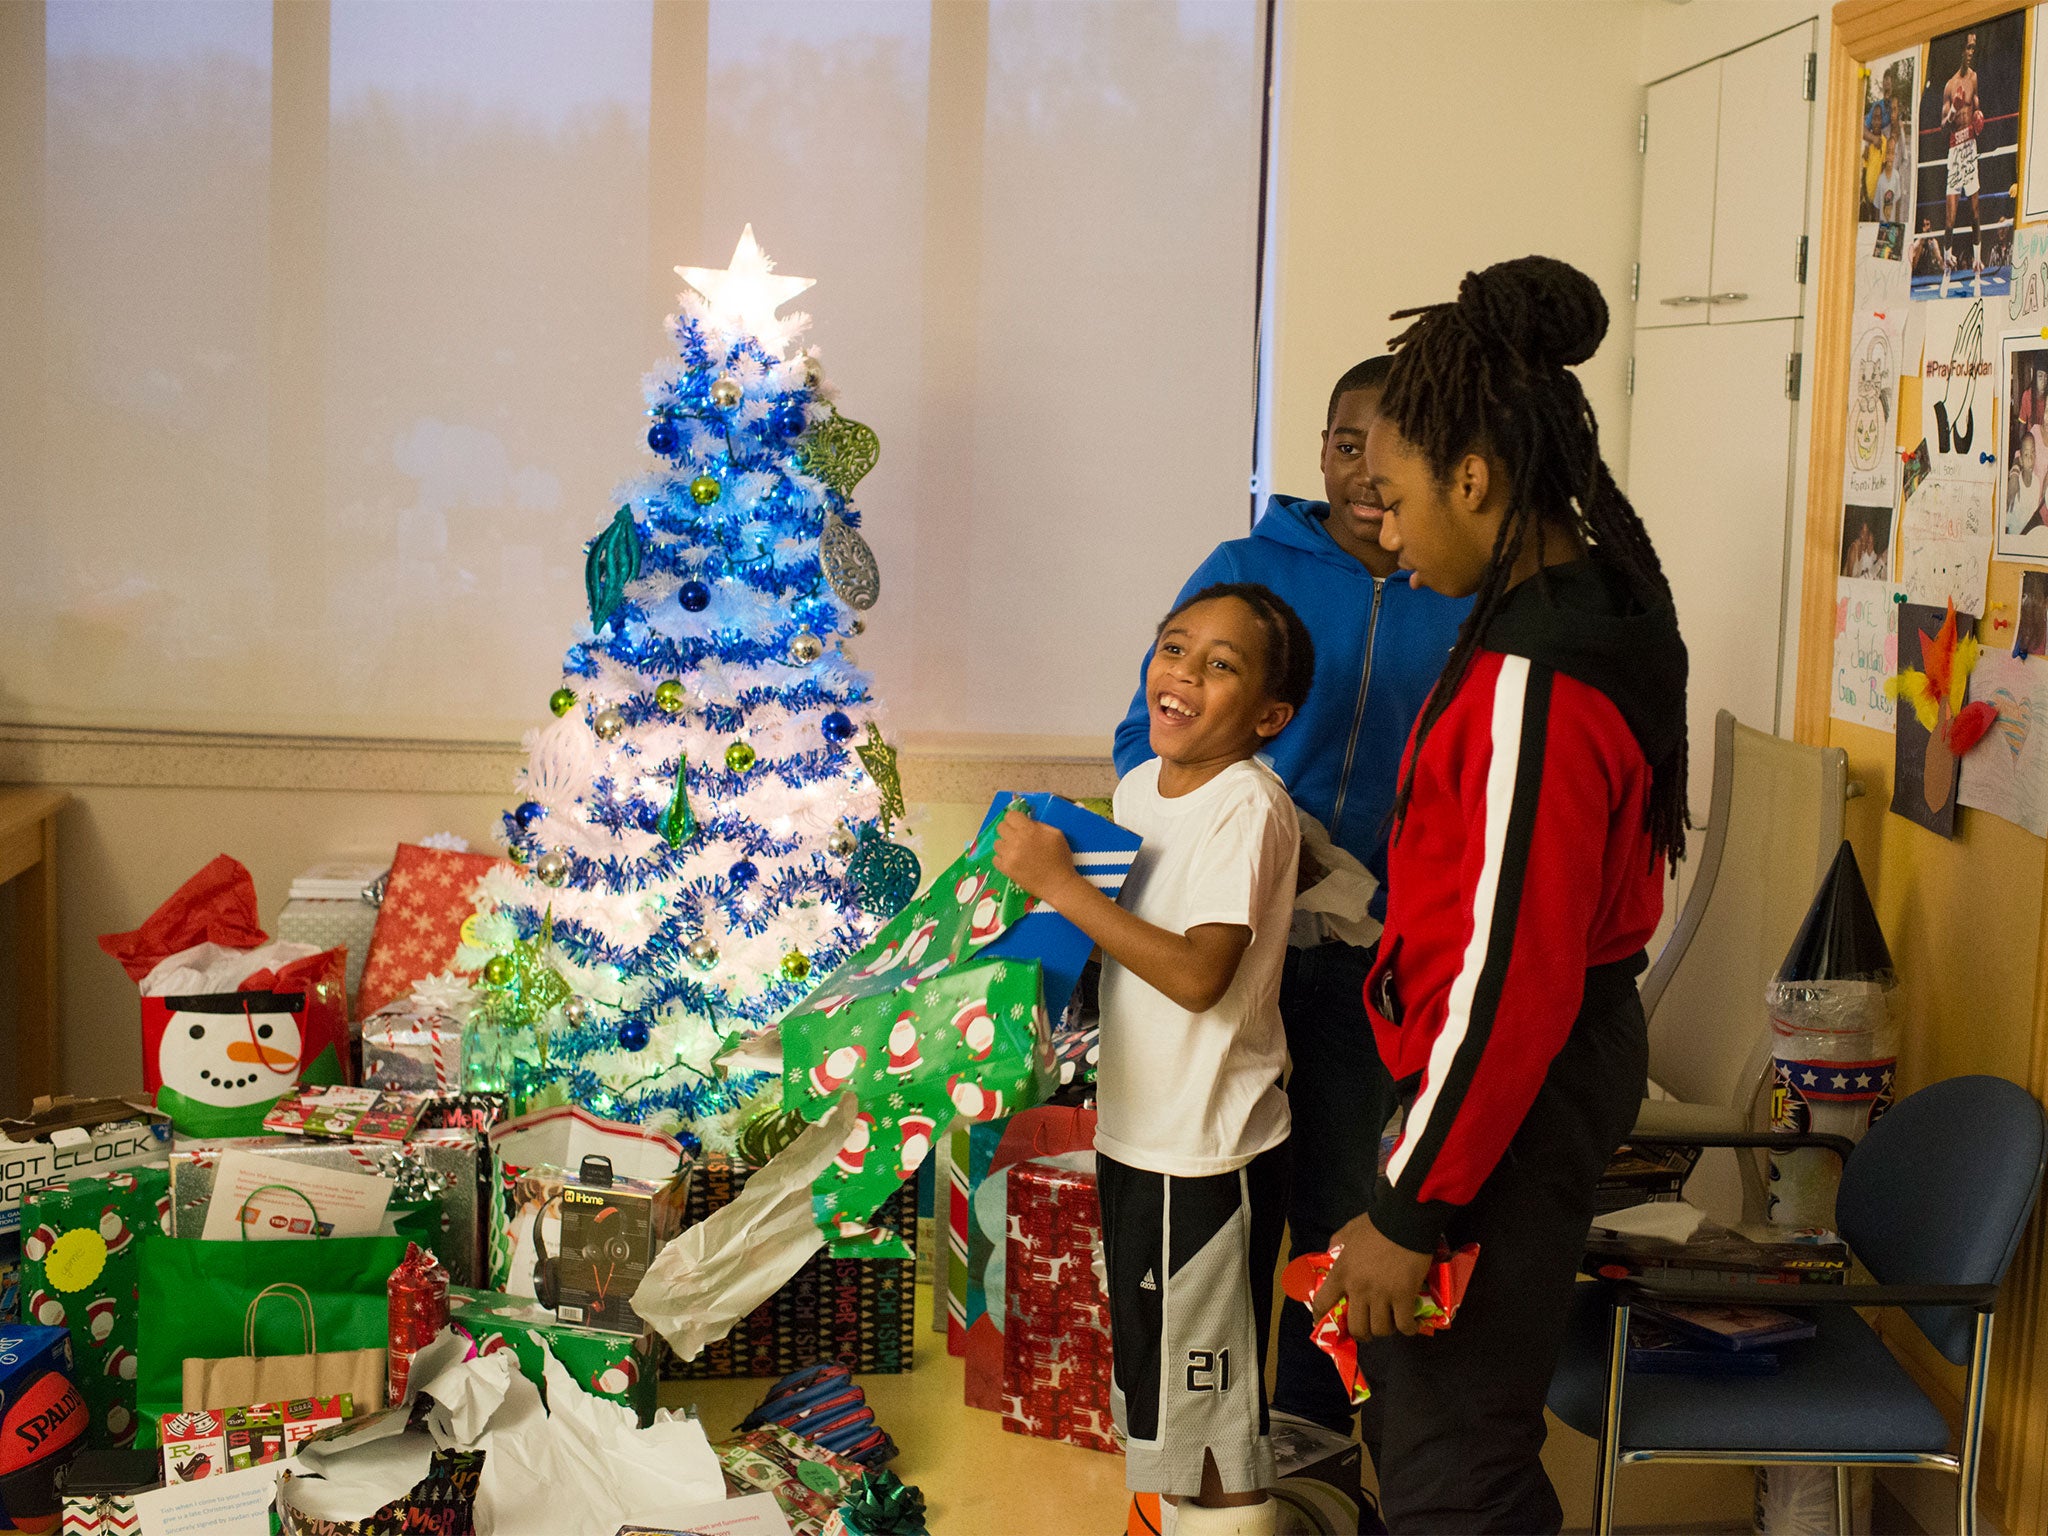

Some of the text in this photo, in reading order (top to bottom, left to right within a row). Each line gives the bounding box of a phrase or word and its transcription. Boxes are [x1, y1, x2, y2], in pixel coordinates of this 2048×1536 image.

[1926, 359, 1993, 382] #PrayForJaydan
[54, 1134, 151, 1171] CLOCK
[575, 1190, 604, 1206] iHome
[1783, 1260, 1845, 1269] NERF
[1139, 1280, 1157, 1291] adidas
[1186, 1347, 1231, 1393] 21
[286, 1424, 317, 1443] H
[168, 1443, 196, 1459] R
[202, 1503, 236, 1515] Christmas
